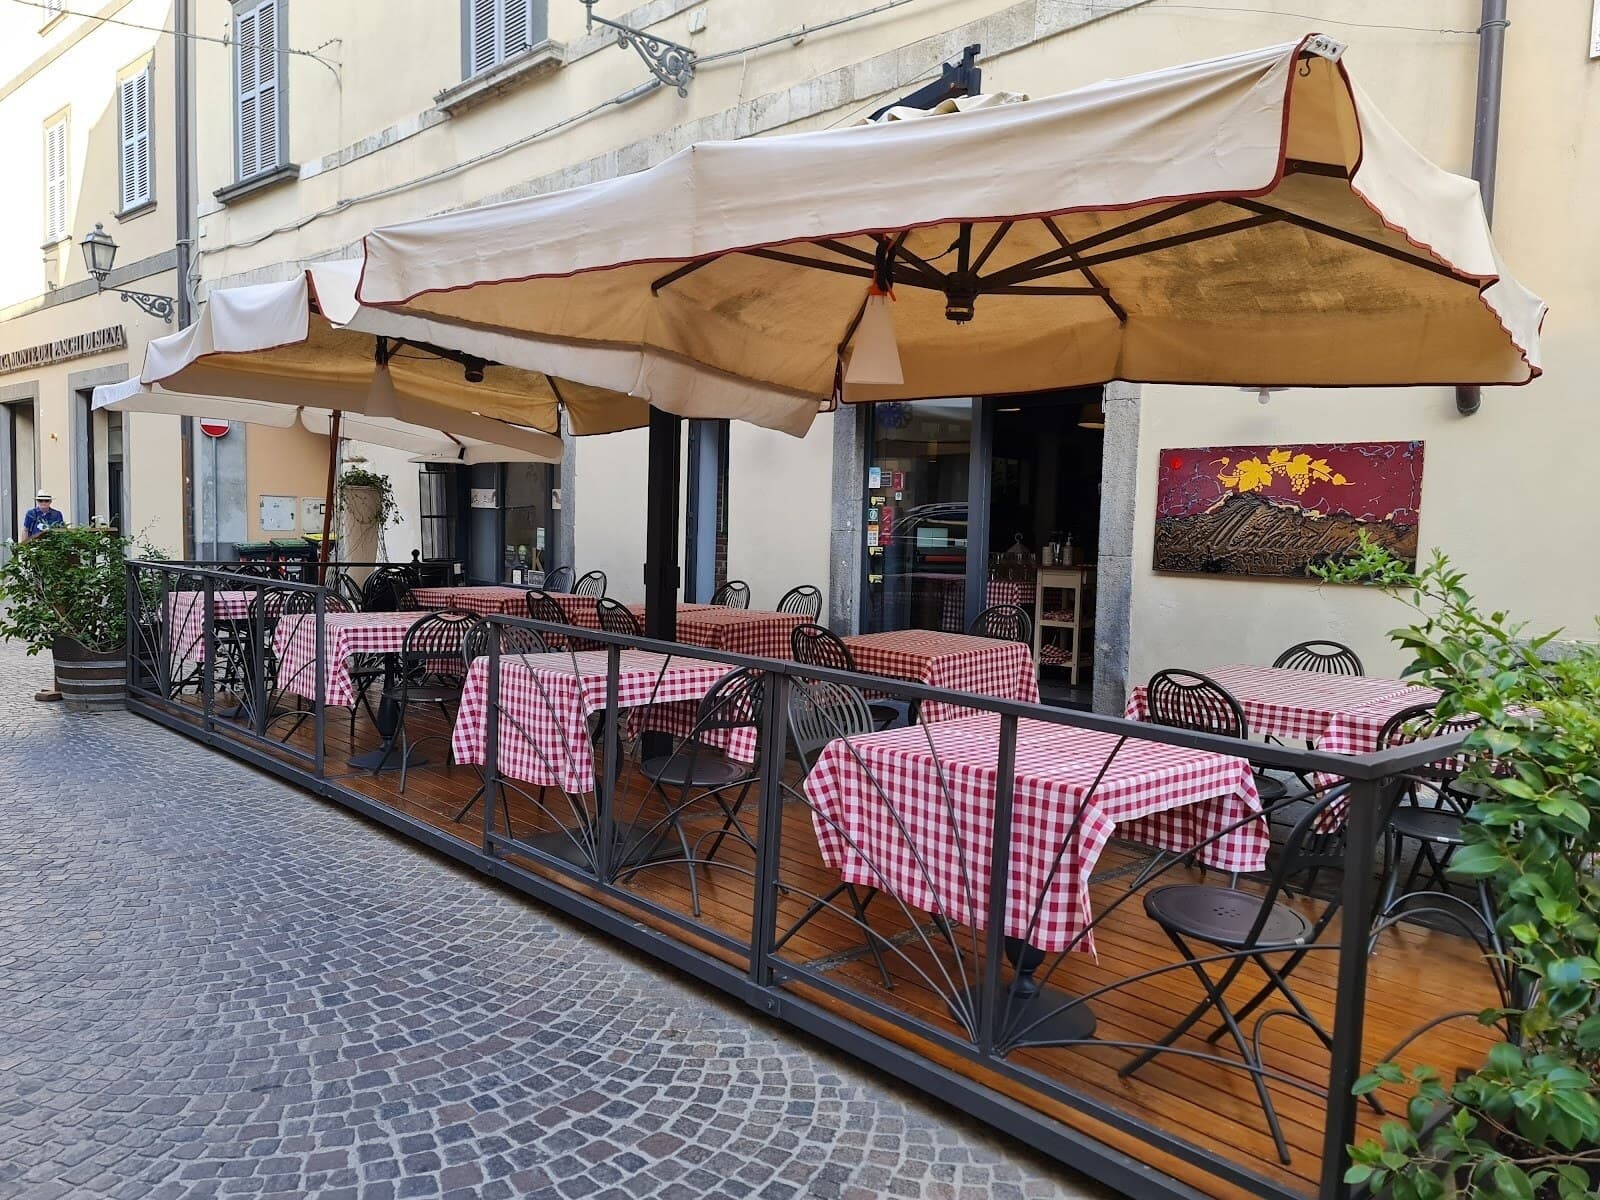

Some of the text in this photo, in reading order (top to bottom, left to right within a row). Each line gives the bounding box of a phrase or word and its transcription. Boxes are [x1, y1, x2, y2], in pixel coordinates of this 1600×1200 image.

[11, 345, 37, 368] MONTE
[38, 342, 53, 361] DEI
[54, 334, 84, 358] PASCHI
[85, 330, 96, 351] DI
[96, 324, 123, 348] SIENA
